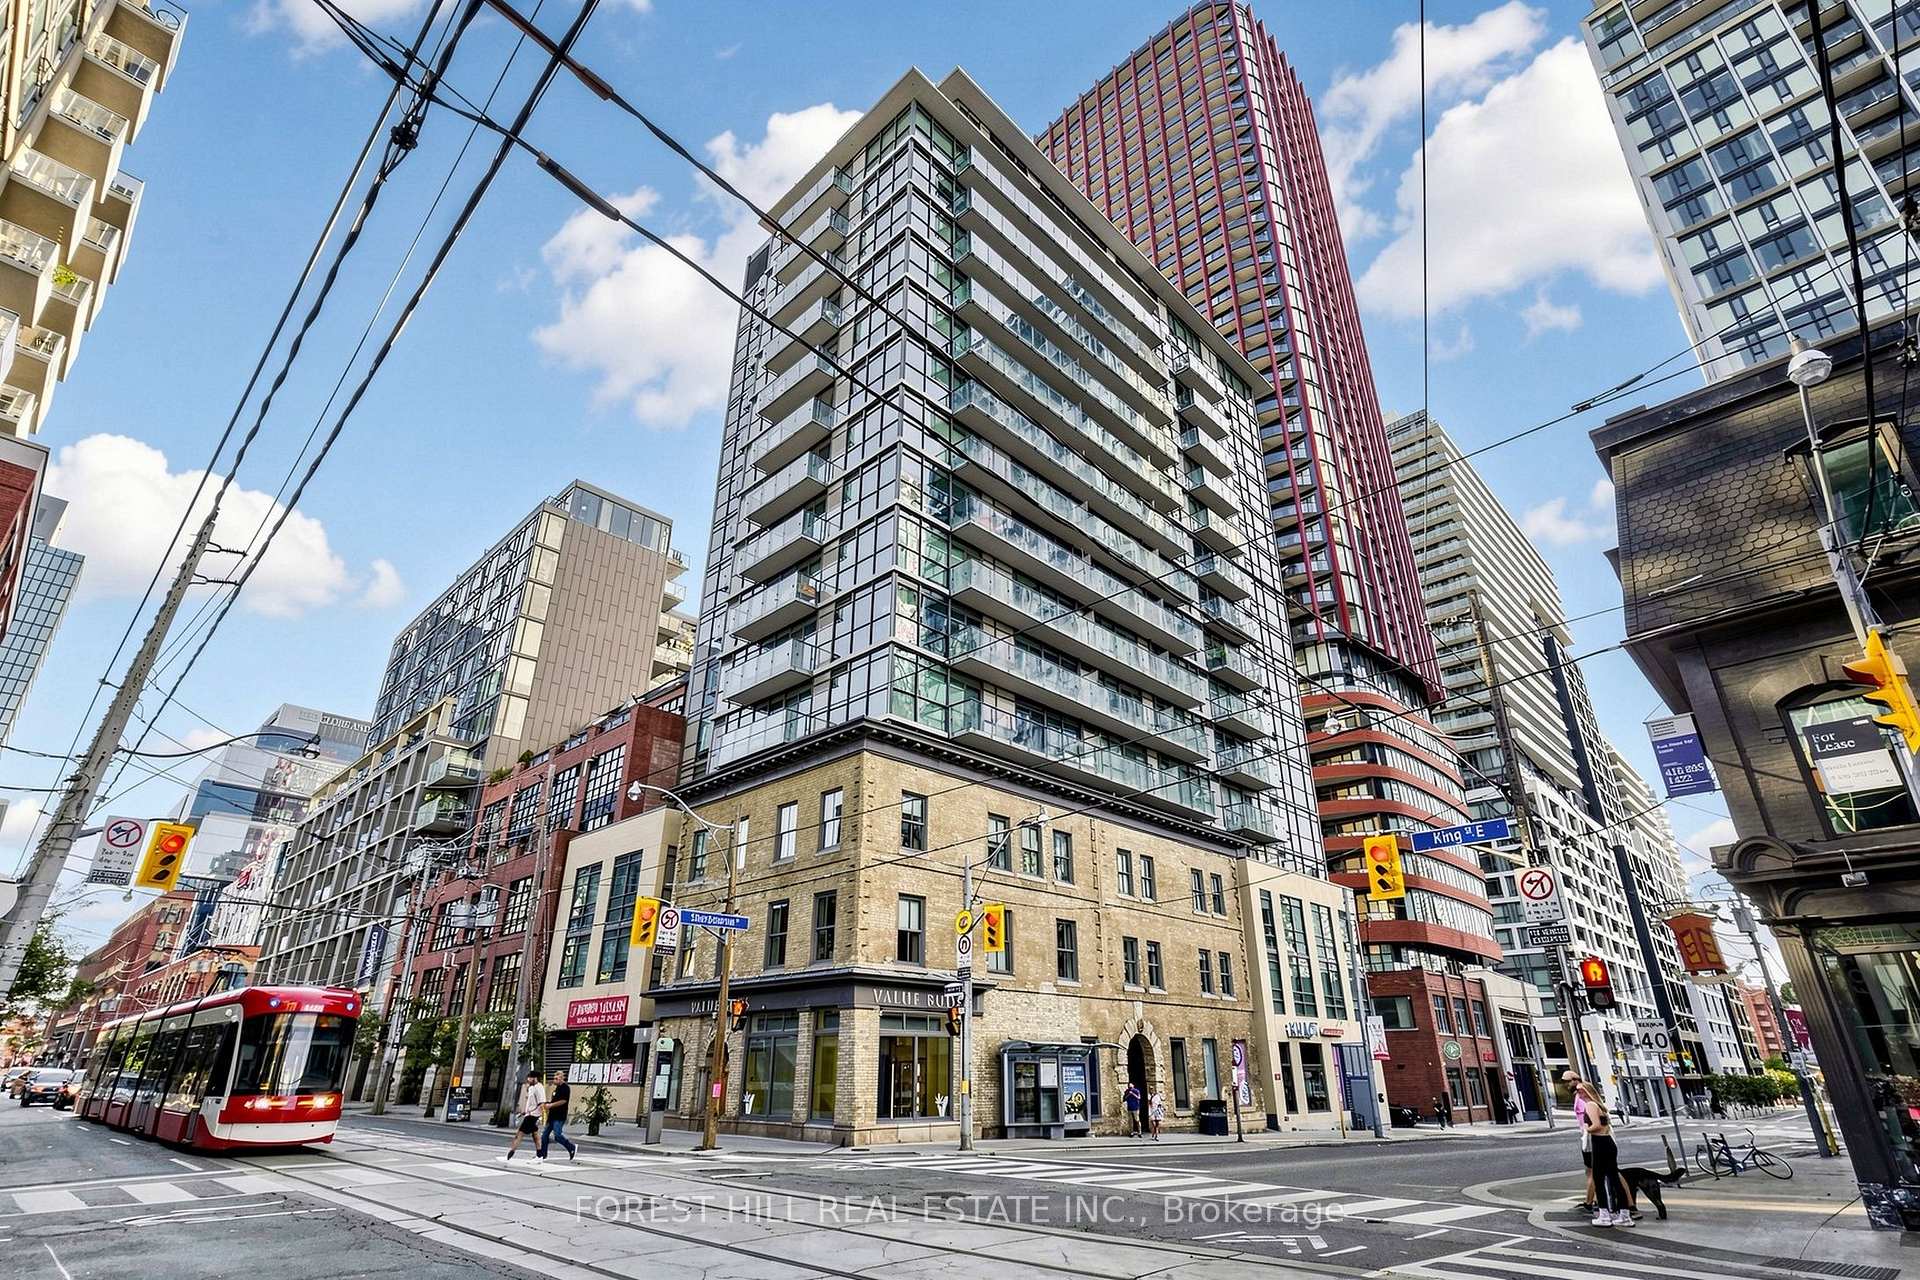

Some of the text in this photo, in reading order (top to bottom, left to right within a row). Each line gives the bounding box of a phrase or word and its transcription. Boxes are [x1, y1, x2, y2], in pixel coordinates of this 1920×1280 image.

[1811, 732, 1836, 743] For
[1815, 739, 1856, 753] Lease
[1432, 830, 1463, 844] King
[1475, 824, 1485, 838] E
[1641, 1032, 1668, 1049] 40
